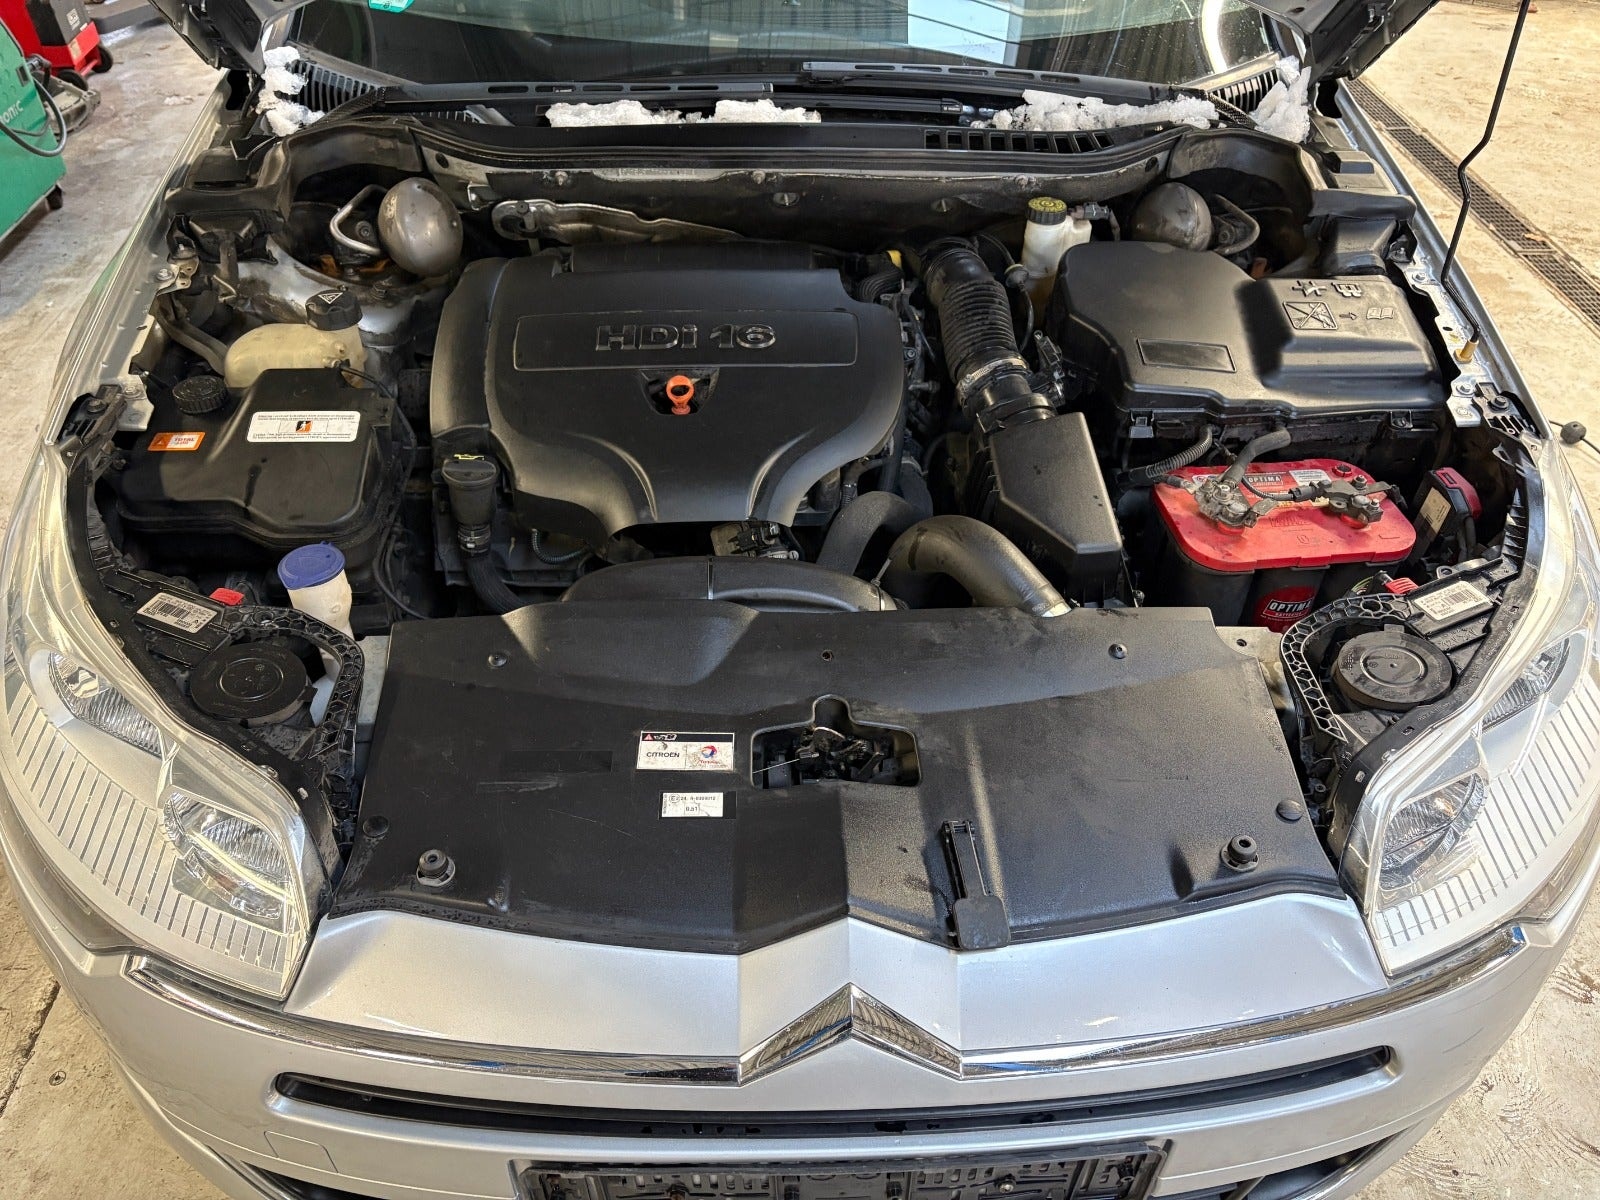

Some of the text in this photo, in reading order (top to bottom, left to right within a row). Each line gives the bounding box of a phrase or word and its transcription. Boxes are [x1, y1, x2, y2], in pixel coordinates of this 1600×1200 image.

[595, 324, 777, 350] HDi 16
[1247, 475, 1282, 483] OPTIMA
